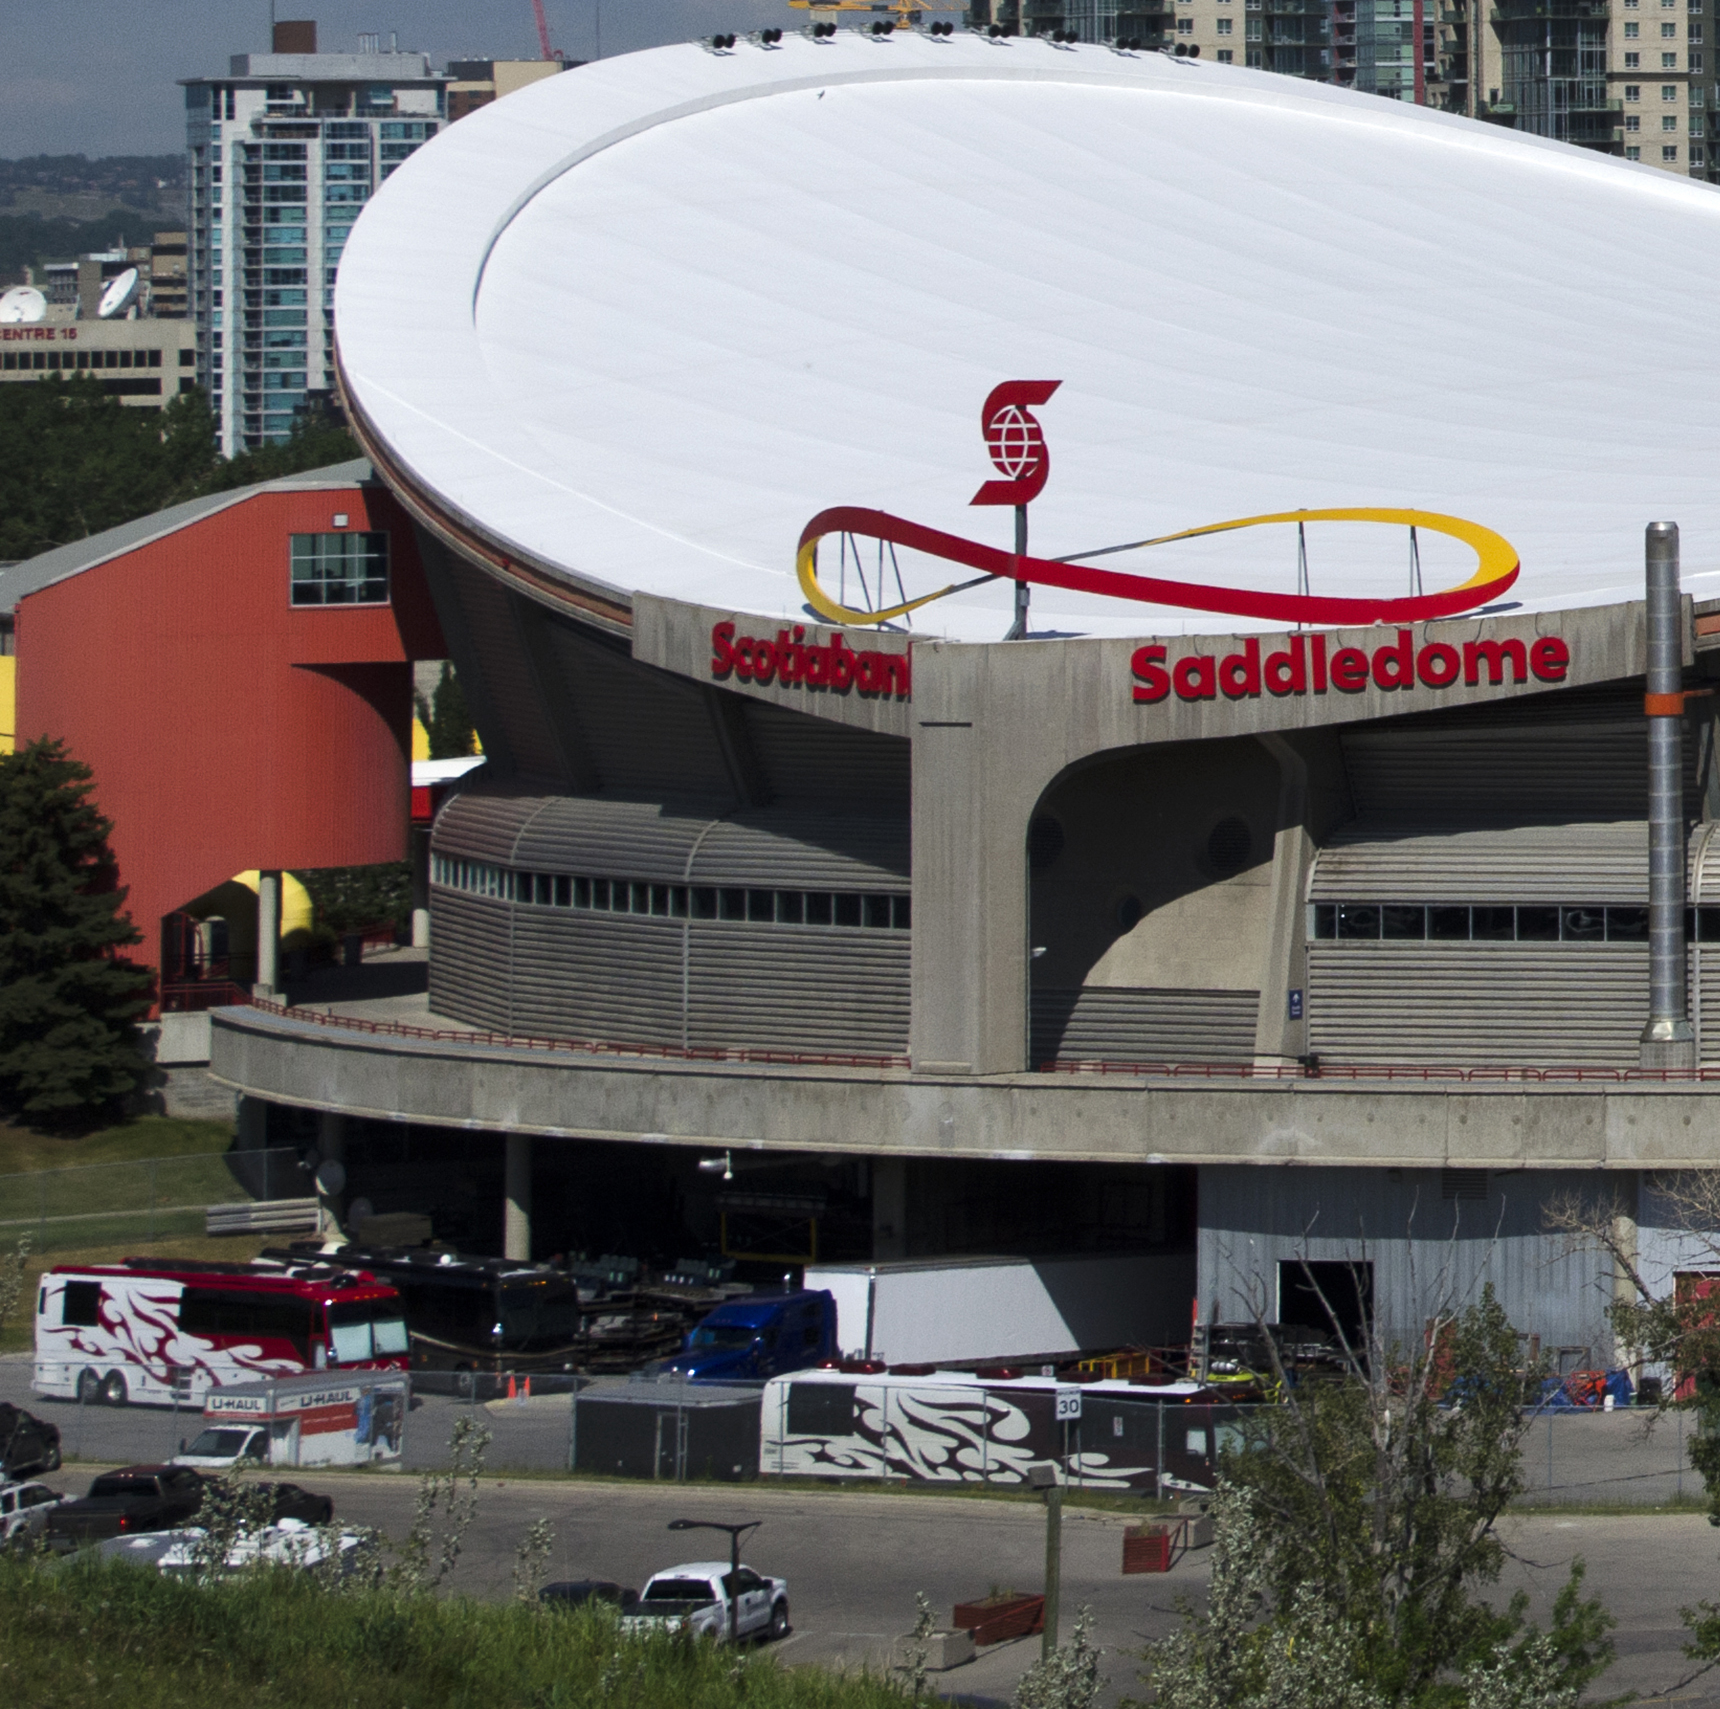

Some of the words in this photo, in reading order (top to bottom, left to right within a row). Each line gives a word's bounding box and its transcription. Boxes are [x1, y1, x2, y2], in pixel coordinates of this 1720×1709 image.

[0, 327, 55, 340] ENTRE
[711, 620, 912, 697] Scotiaban
[1130, 629, 1569, 703] Saddledome
[211, 1398, 261, 1411] U-HAUL
[300, 1390, 354, 1408] U-HAUL
[1059, 1398, 1079, 1414] 30
